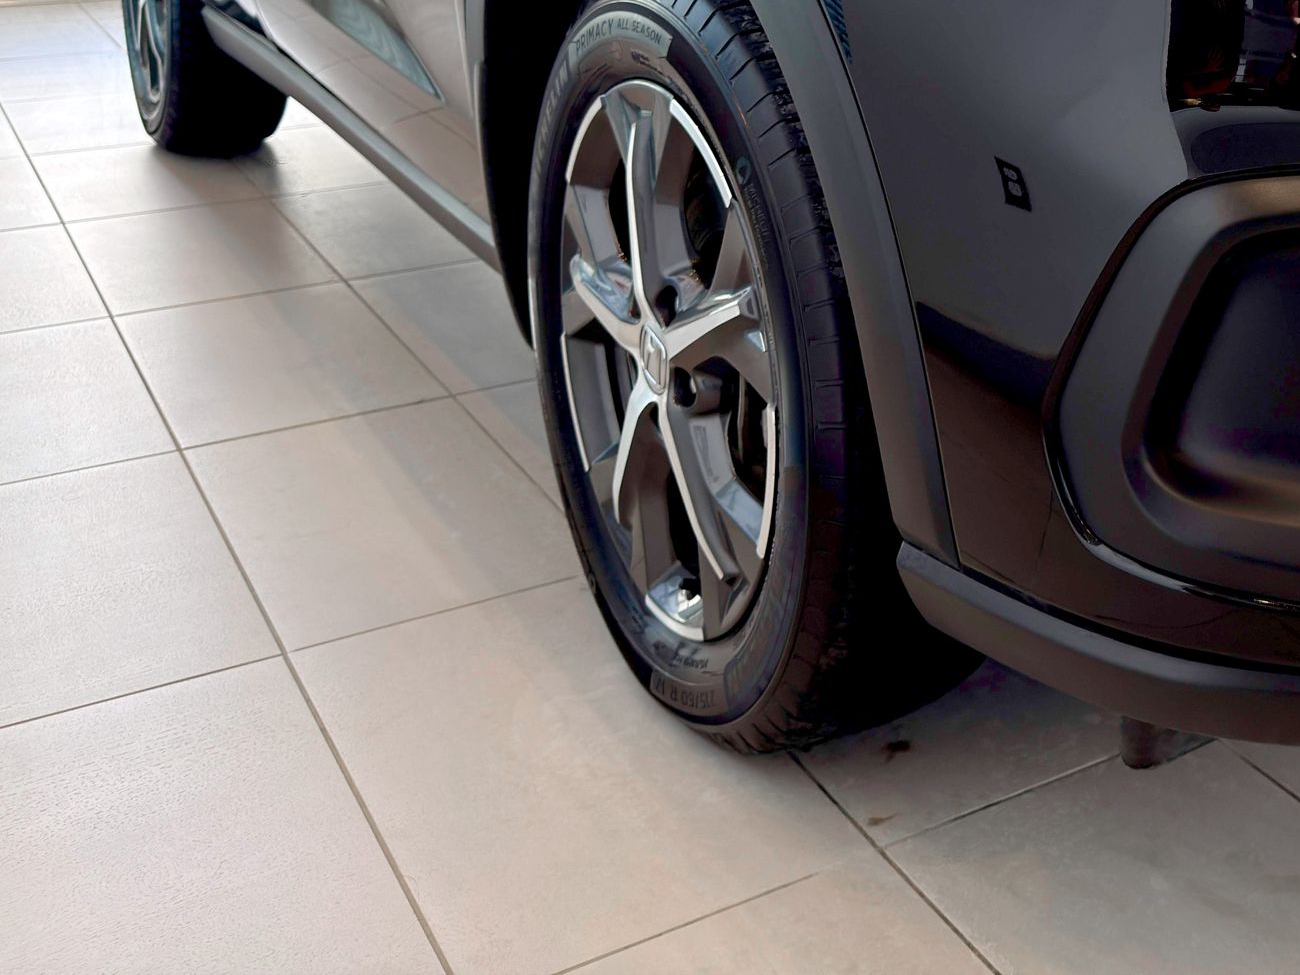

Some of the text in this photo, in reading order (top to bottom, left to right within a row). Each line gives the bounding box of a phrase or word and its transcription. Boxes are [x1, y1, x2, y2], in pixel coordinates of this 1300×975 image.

[575, 17, 662, 56] PRIMACY ALL SEASON
